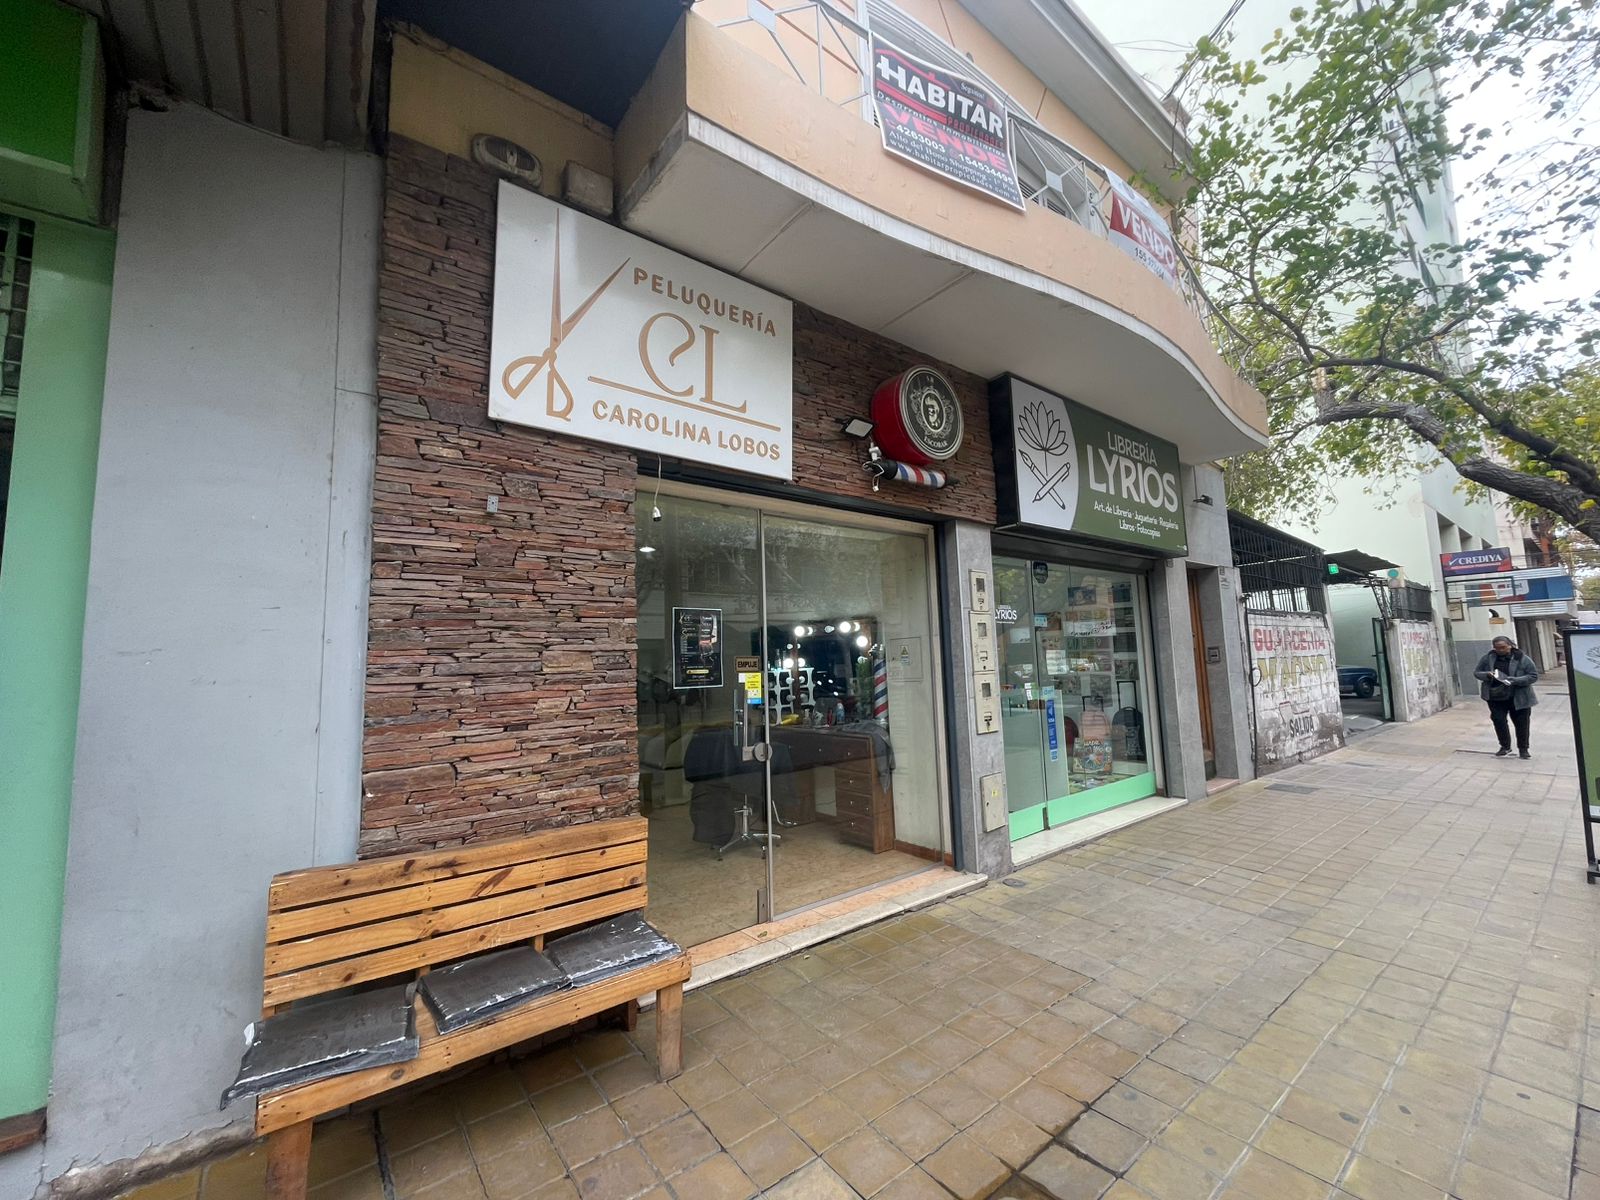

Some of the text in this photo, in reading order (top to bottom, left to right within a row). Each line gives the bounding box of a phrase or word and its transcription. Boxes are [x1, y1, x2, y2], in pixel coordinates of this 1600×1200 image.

[876, 54, 1004, 139] HABITAR
[883, 102, 1010, 174] VENDE
[1117, 199, 1175, 270] VENDO
[633, 267, 776, 337] PELUQUERÍA
[638, 312, 746, 414] CL
[592, 400, 781, 461] CAROLINA LOBOS
[1108, 431, 1158, 467] LIBRERÍA
[1087, 444, 1178, 512] LYRIOS
[1094, 500, 1105, 512] Art.
[1105, 502, 1113, 514] de
[1119, 519, 1161, 539] Libros Fotocopias
[1458, 554, 1502, 565] CREDIYA
